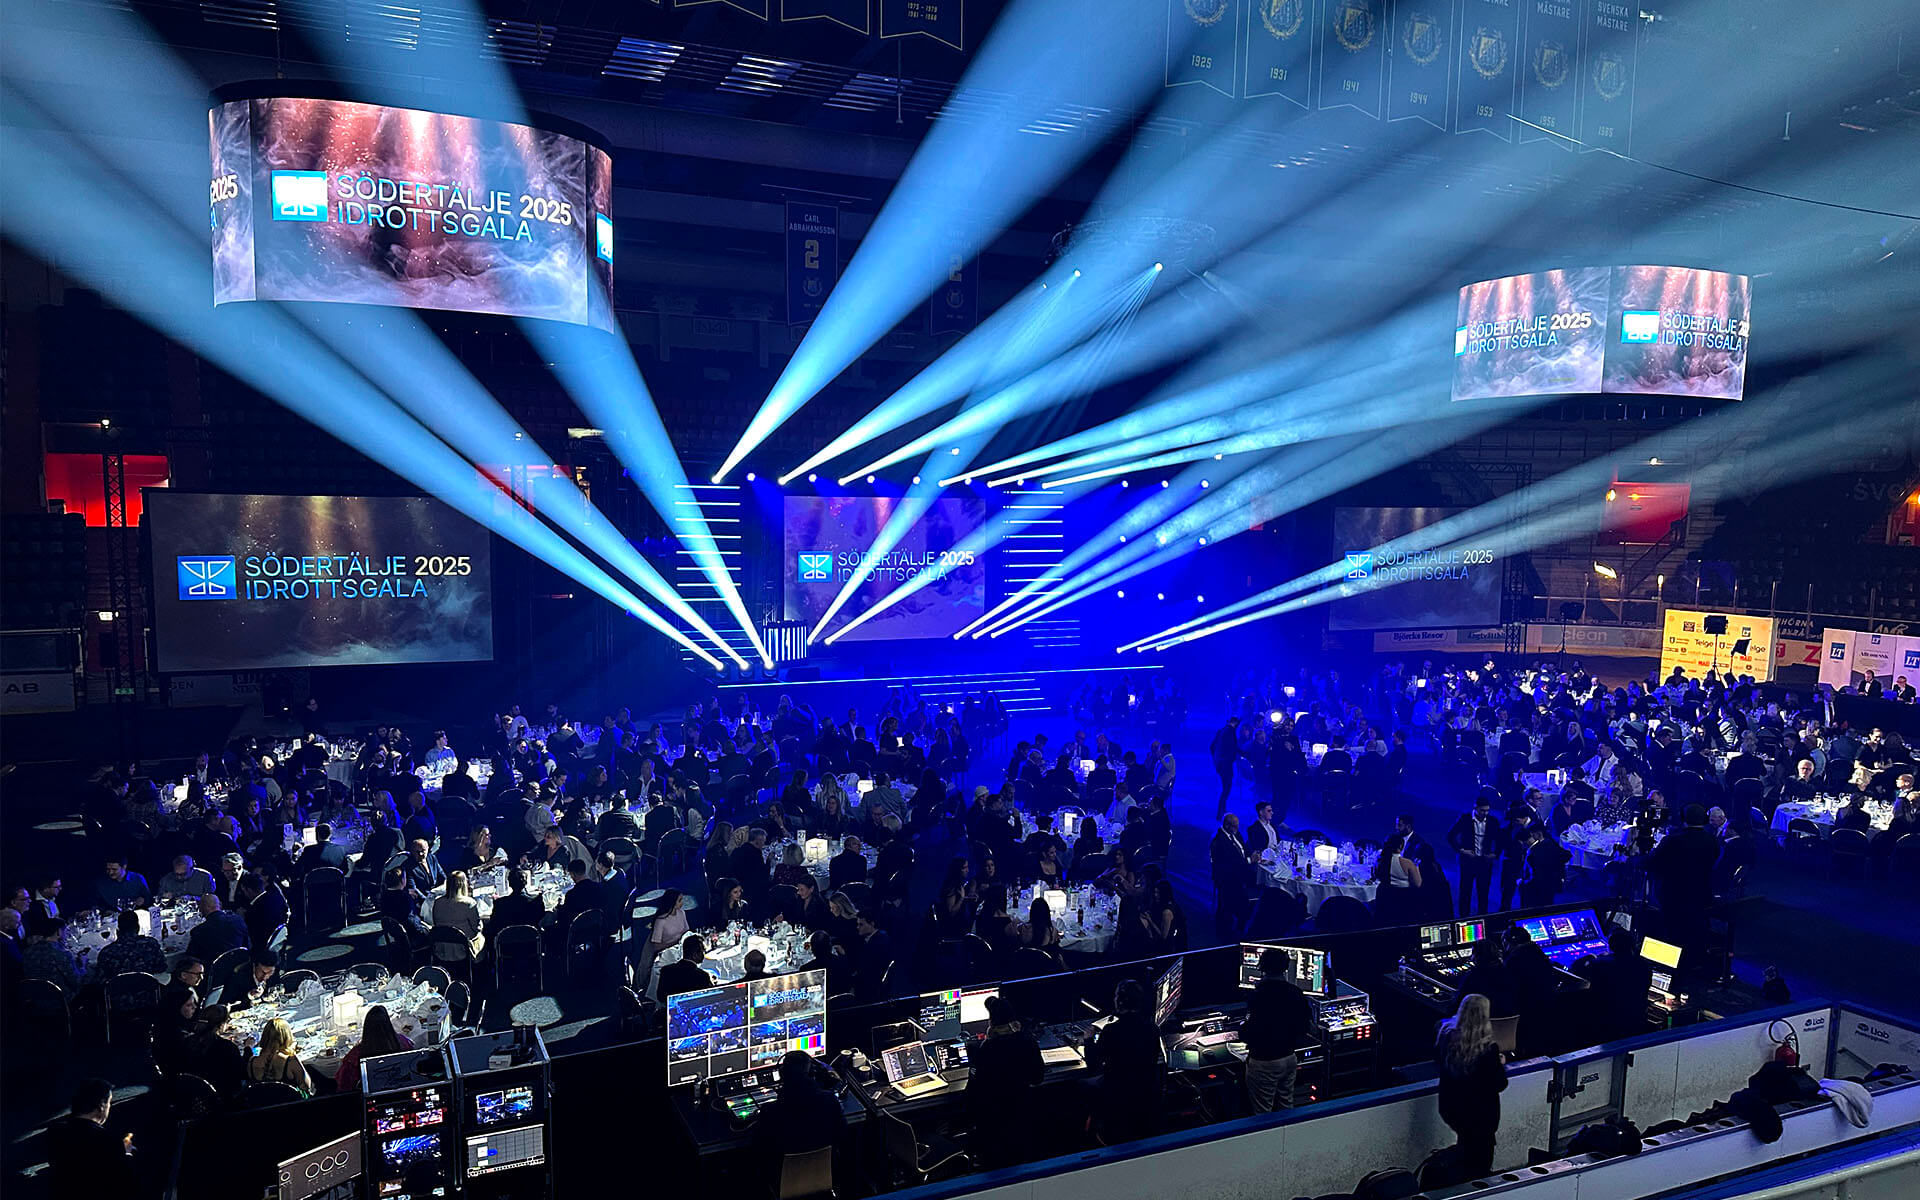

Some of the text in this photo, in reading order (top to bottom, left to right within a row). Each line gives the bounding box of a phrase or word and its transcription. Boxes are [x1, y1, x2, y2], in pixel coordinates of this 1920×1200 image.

[1597, 1, 1629, 17] SVENSKA
[1191, 54, 1213, 69] 1925
[1270, 66, 1288, 81] 1931
[1342, 79, 1360, 94] 1941
[1409, 91, 1428, 105] 1944
[1476, 104, 1494, 118] 1953
[337, 171, 572, 226] SÖDERTÄLJE 2025
[337, 201, 534, 243] IDROTTSGALA
[804, 239, 819, 269] 2
[1469, 312, 1592, 340] SÖDERTÄLJE 2025
[1662, 309, 1738, 334] SÖDERTÄLJE
[1468, 331, 1558, 354] IDROTTSGALA
[1661, 329, 1742, 351] IDROTTSGALA
[244, 551, 472, 577] SÖDERTÄLJE 2025
[939, 550, 975, 566] 2025
[1377, 547, 1494, 566] SÖDERTÄLJE 2025
[1375, 565, 1470, 581] IDROTTSGALA
[245, 578, 429, 600] IDROTTSGALA
[1422, 631, 1445, 640] Resor
[1565, 629, 1608, 642] clean
[1695, 639, 1715, 649] Telge
[1831, 647, 1845, 659] LT
[1905, 656, 1920, 667] LT
[4, 683, 41, 695] AB
[152, 910, 161, 919] 25
